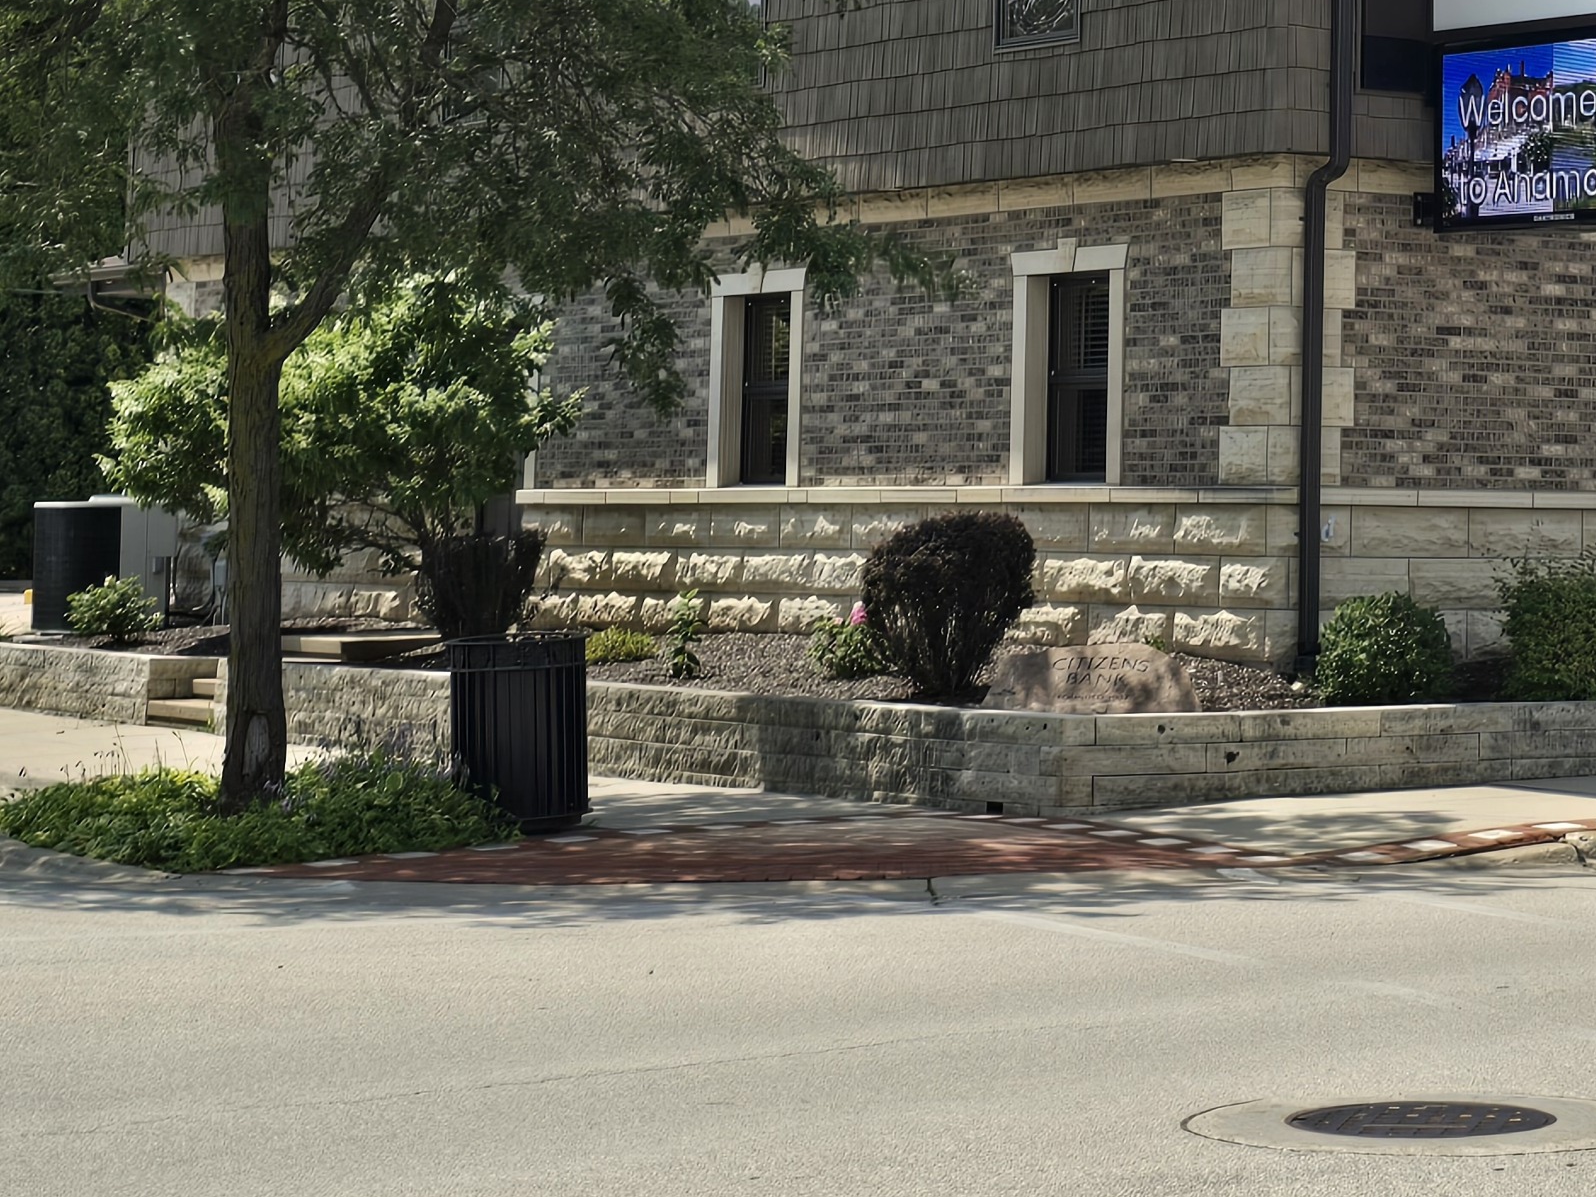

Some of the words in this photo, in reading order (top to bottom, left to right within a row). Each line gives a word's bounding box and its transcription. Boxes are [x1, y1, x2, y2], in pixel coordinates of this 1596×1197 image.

[1459, 89, 1596, 128] Welcome
[1459, 172, 1487, 204] to
[1052, 656, 1149, 673] CITIZENS
[1065, 672, 1126, 687] BANK
